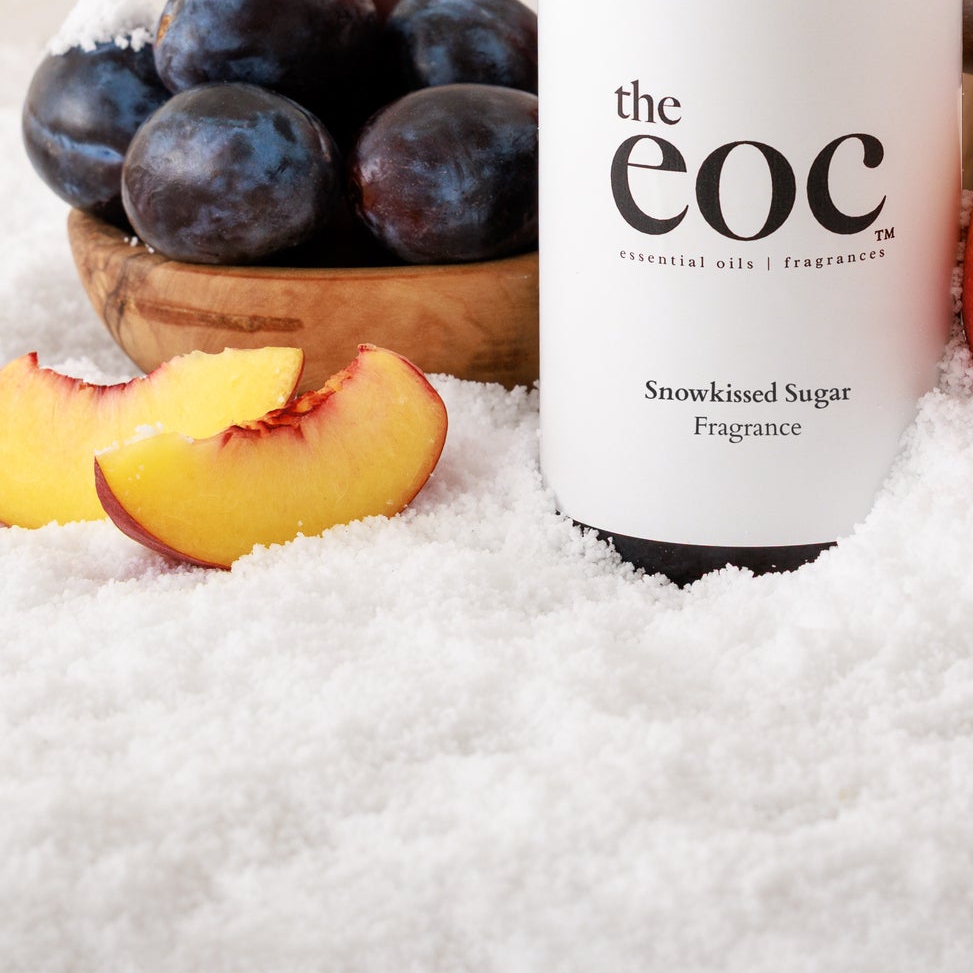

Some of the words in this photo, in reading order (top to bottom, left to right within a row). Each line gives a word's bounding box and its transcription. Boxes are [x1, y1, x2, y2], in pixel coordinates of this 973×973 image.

[615, 80, 681, 125] the
[611, 133, 886, 241] eoc
[619, 248, 705, 268] essential
[716, 257, 754, 270] oils
[784, 248, 885, 269] fragrances
[646, 381, 777, 402] Snowkissed
[785, 384, 851, 409] Sugar
[694, 417, 801, 443] Fragrance
